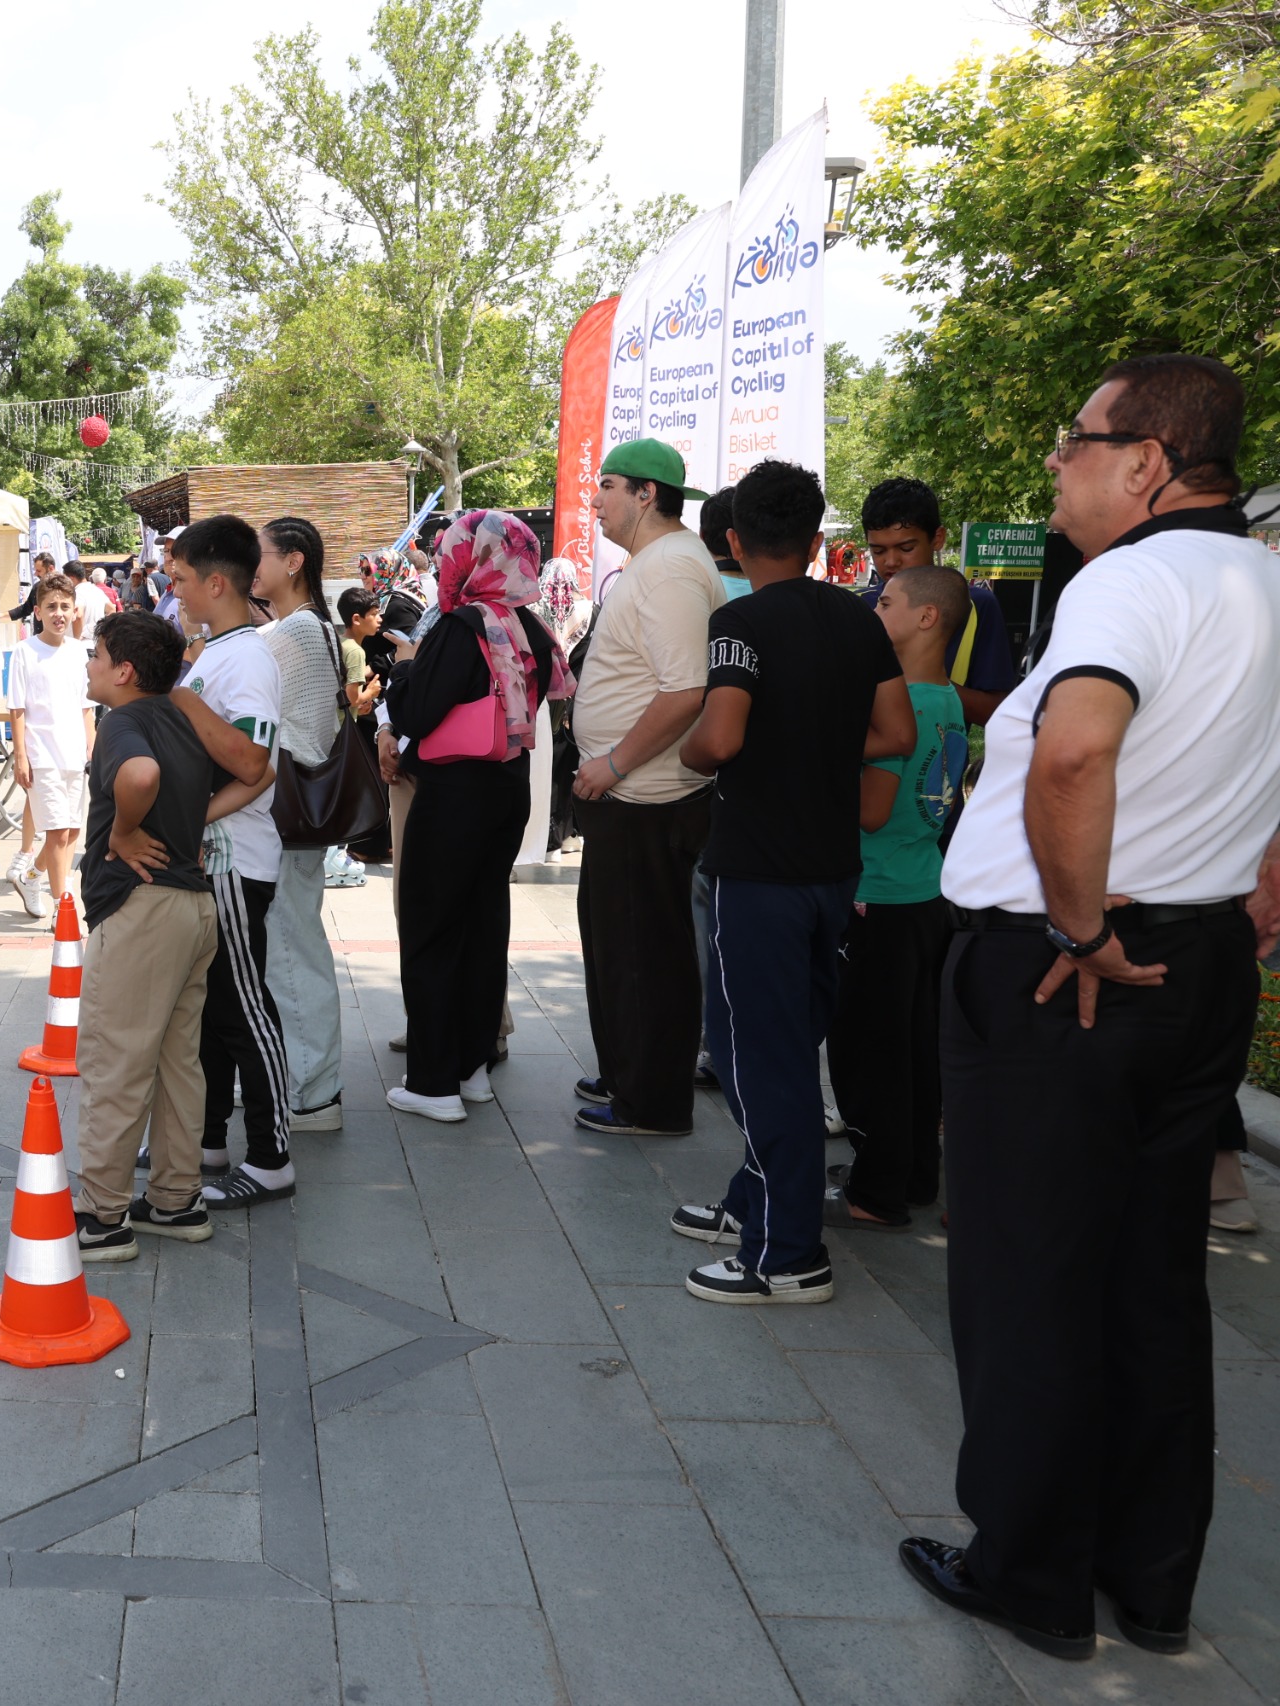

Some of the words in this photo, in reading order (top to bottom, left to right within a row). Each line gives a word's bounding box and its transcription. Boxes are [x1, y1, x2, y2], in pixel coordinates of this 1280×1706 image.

[649, 307, 723, 349] Konya
[792, 332, 814, 355] of
[649, 362, 714, 384] European
[613, 385, 642, 401] Europ
[649, 384, 699, 407] Capital
[701, 382, 718, 399] of
[649, 410, 696, 431] Cycling
[579, 438, 594, 484] Şehri
[578, 488, 592, 554] Bisiklet
[988, 528, 1036, 542] ÇEVREMİZİ
[977, 543, 1004, 556] TEMİZ
[1007, 545, 1044, 557] TUTALIM
